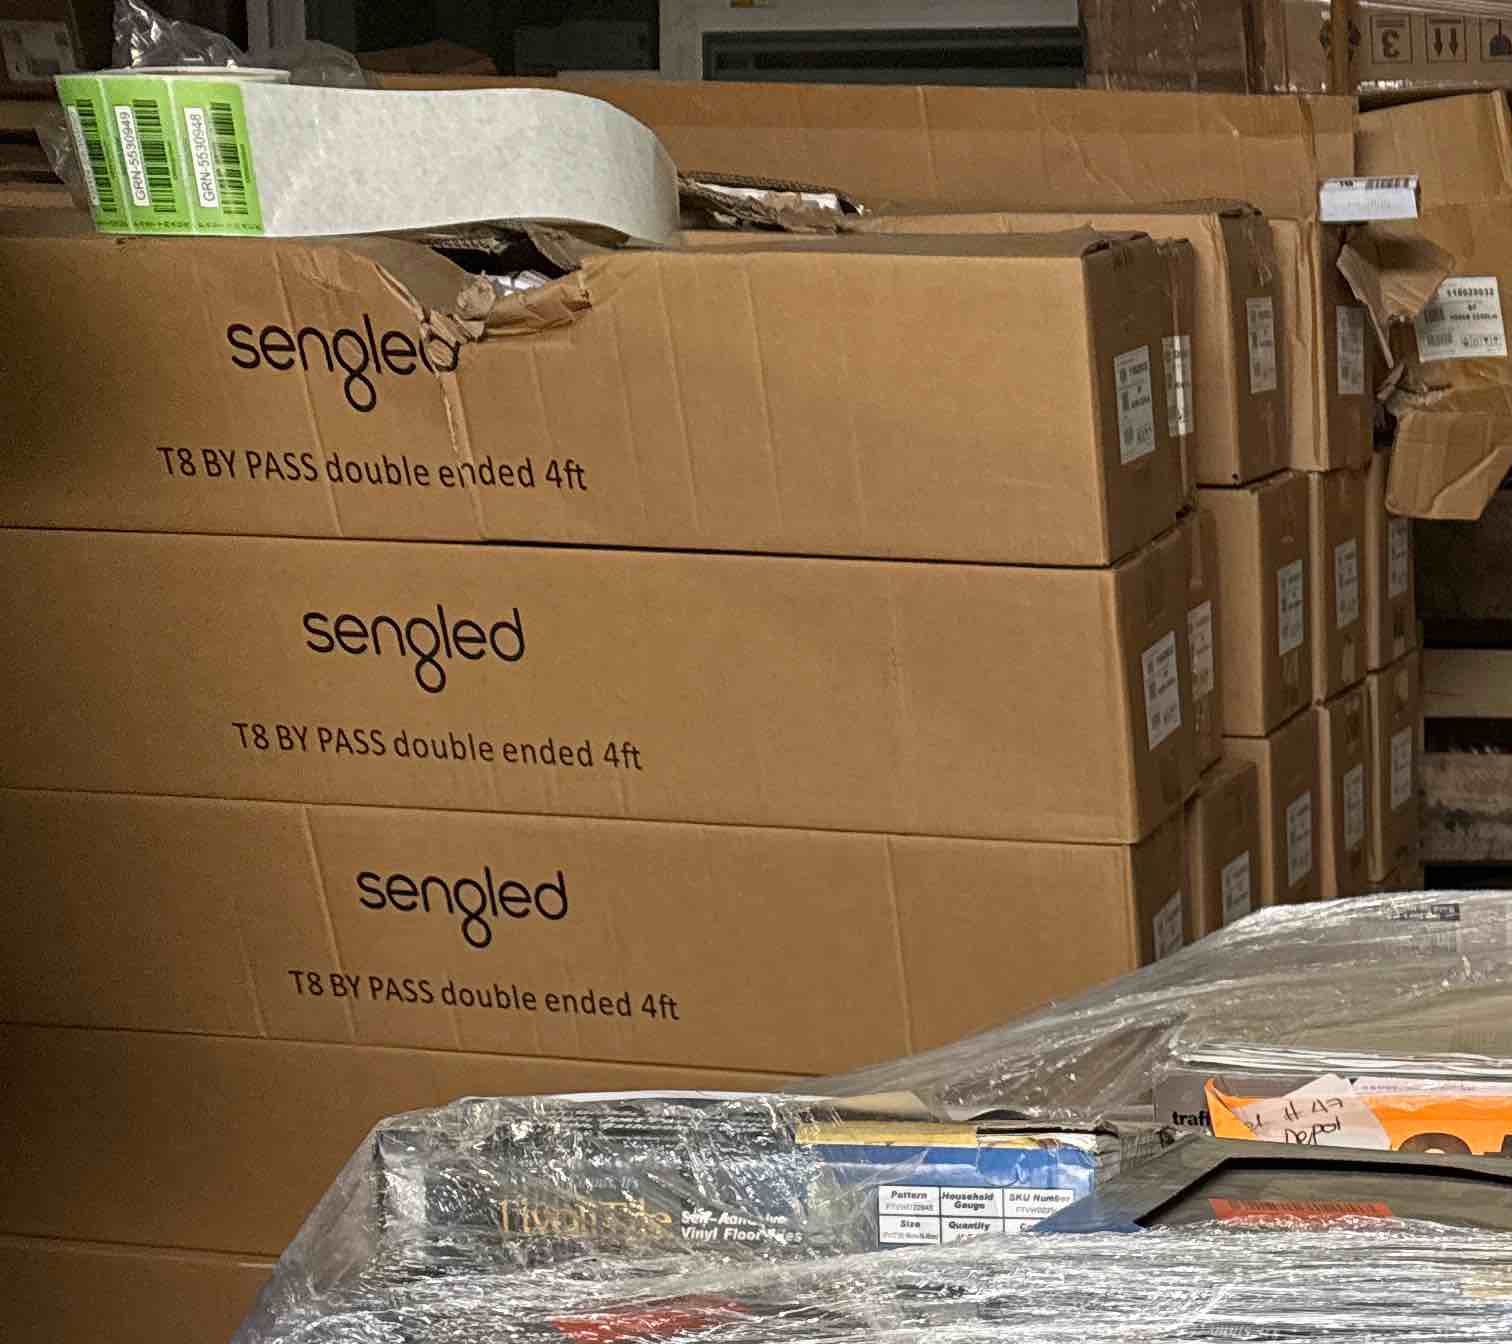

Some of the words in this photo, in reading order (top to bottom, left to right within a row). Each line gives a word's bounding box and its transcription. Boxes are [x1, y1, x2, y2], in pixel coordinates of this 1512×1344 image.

[157, 446, 196, 478] T8
[205, 449, 236, 481] BY
[246, 450, 319, 484] PASS
[326, 452, 432, 489] double
[439, 458, 537, 490] ended
[545, 459, 588, 492] 4ft
[303, 604, 525, 693] sengled
[232, 722, 270, 752] T8
[275, 724, 309, 754] BY
[318, 727, 387, 758] PASS
[393, 730, 494, 764] double
[502, 736, 593, 768] ended
[602, 740, 643, 771] 4ft
[356, 866, 568, 948] sengled
[289, 970, 324, 998] T8
[329, 973, 363, 1000] BY
[368, 976, 435, 1004] PASS
[441, 981, 537, 1012] double
[545, 986, 632, 1017] ended
[640, 992, 679, 1021] 4ft
[891, 1190, 928, 1200] Pattern
[942, 1191, 994, 1202] Household
[954, 1201, 985, 1210] Gauge
[1008, 1193, 1031, 1202] SKU
[680, 1226, 718, 1242] Vinyl
[723, 1227, 762, 1242] Floor
[900, 1219, 921, 1229] Size
[948, 1221, 990, 1232] Quantity
